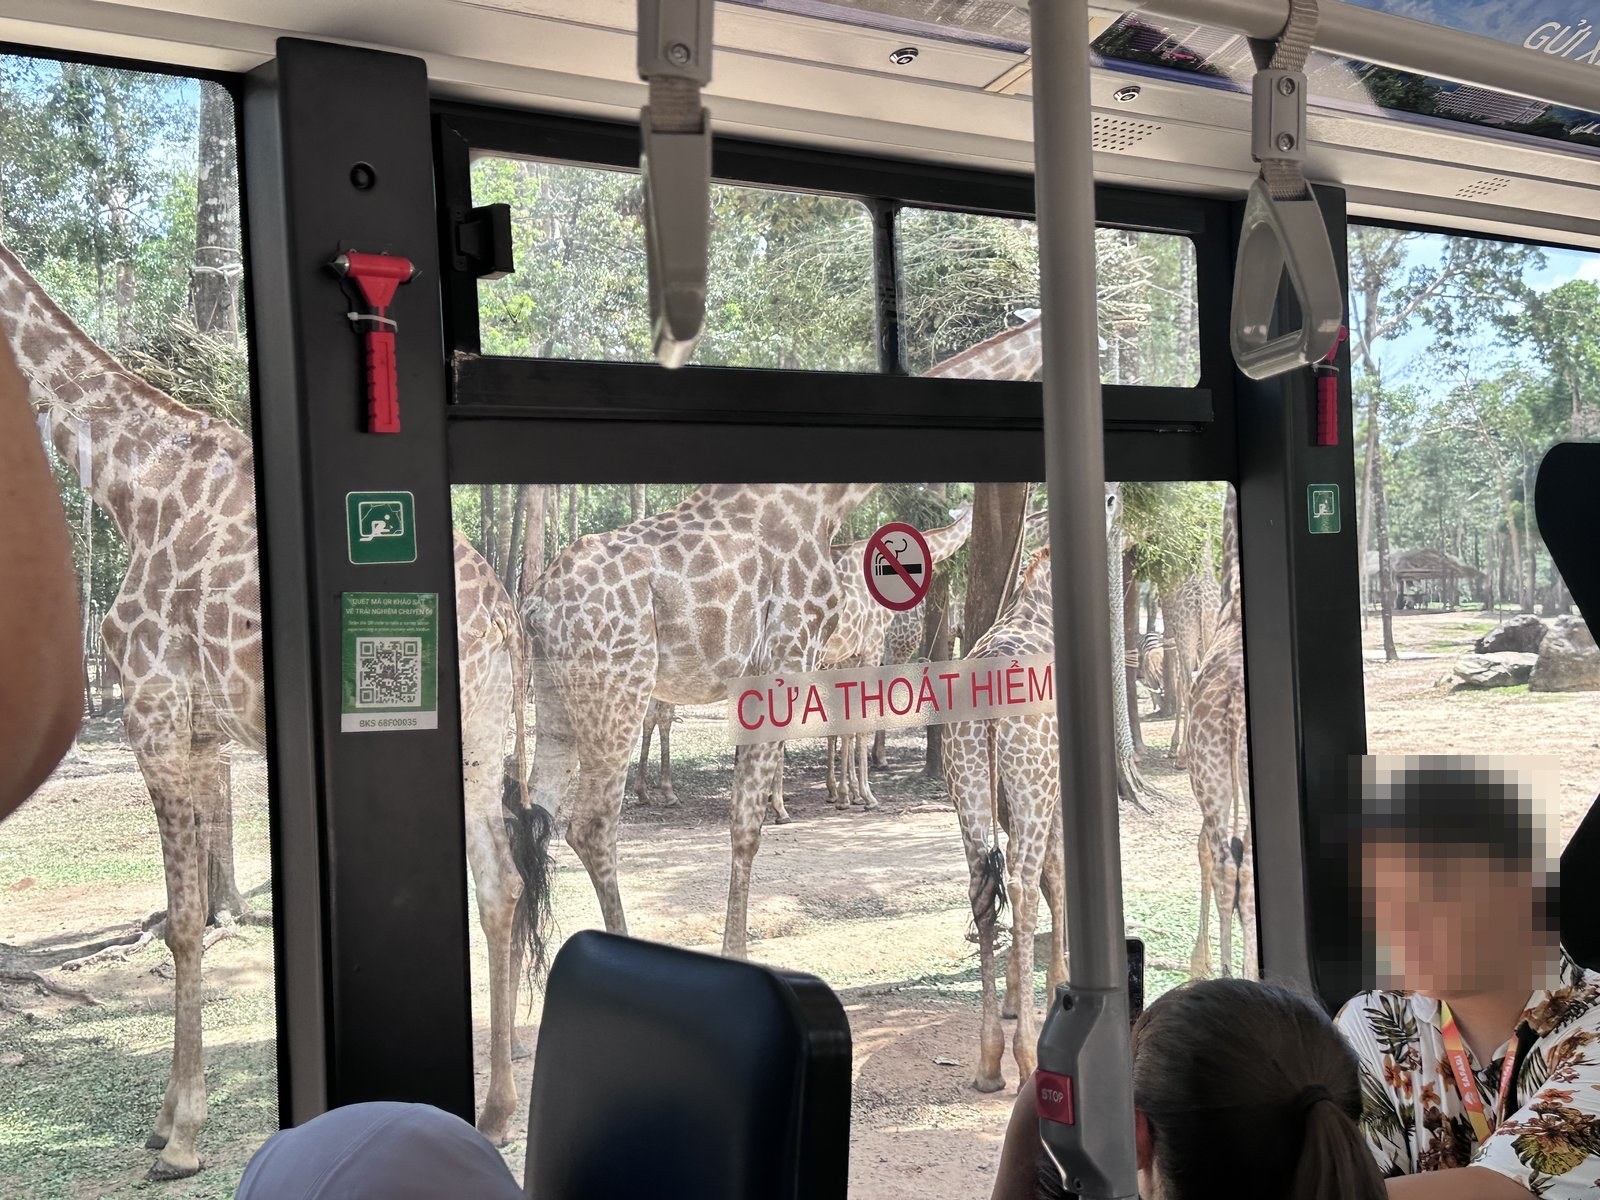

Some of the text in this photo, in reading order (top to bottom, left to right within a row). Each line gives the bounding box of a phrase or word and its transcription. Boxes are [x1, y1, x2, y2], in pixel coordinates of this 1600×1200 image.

[1523, 19, 1592, 57] GỬI
[737, 659, 1054, 731] CỬA THOÁT HIỂM
[359, 719, 376, 728] BKS
[1453, 1055, 1471, 1088] SAFARI
[1041, 1088, 1064, 1103] STOP
